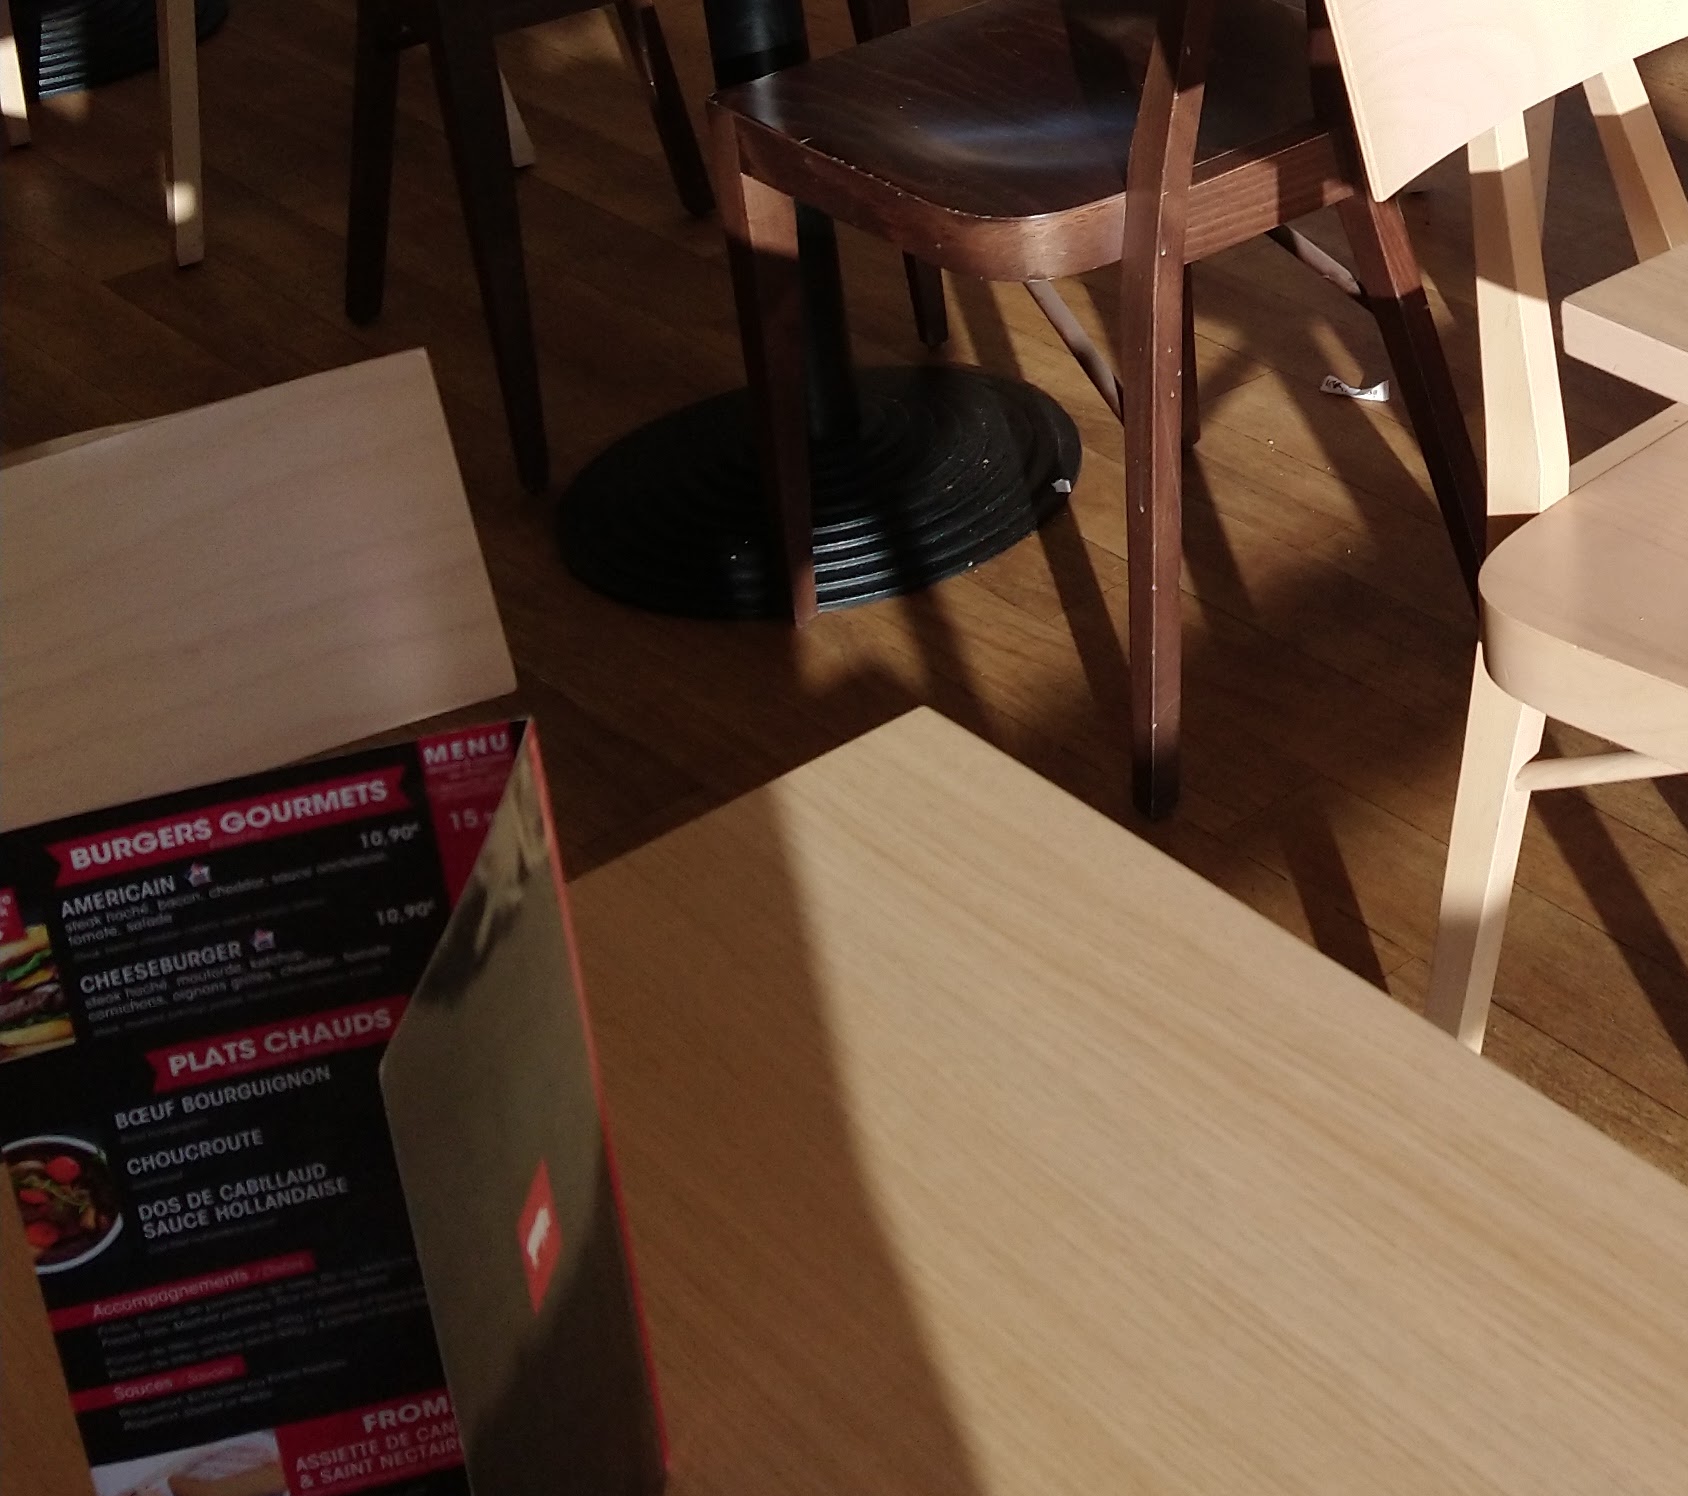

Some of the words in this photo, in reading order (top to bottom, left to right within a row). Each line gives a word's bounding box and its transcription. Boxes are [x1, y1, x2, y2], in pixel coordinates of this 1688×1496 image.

[423, 731, 509, 765] MENU
[70, 817, 213, 872] BURGERS
[219, 779, 389, 837] GOURMETS
[61, 874, 176, 920] AMERICAIN
[79, 940, 242, 995] CHEESEBURGER
[167, 1036, 258, 1078] PLATS
[263, 1008, 392, 1056] CHAUDS
[114, 1100, 176, 1130] BŒUF
[181, 1065, 332, 1114] BOURGUIGNON
[126, 1127, 264, 1176] CHOUCROUTE
[137, 1196, 182, 1223] DOS
[186, 1188, 215, 1211] DE
[219, 1162, 328, 1202] CABILLAUD
[142, 1208, 212, 1240] SAUCE
[215, 1176, 350, 1223] HOLLANDAISE
[92, 1269, 250, 1319] Accompagnements
[112, 1378, 174, 1402] Sauces
[362, 1395, 452, 1434] FROM
[296, 1439, 380, 1473] ASSIETTE
[385, 1431, 411, 1451] DE
[300, 1473, 314, 1489] &
[320, 1457, 373, 1485] SAINT
[380, 1436, 462, 1469] NECTAIR
